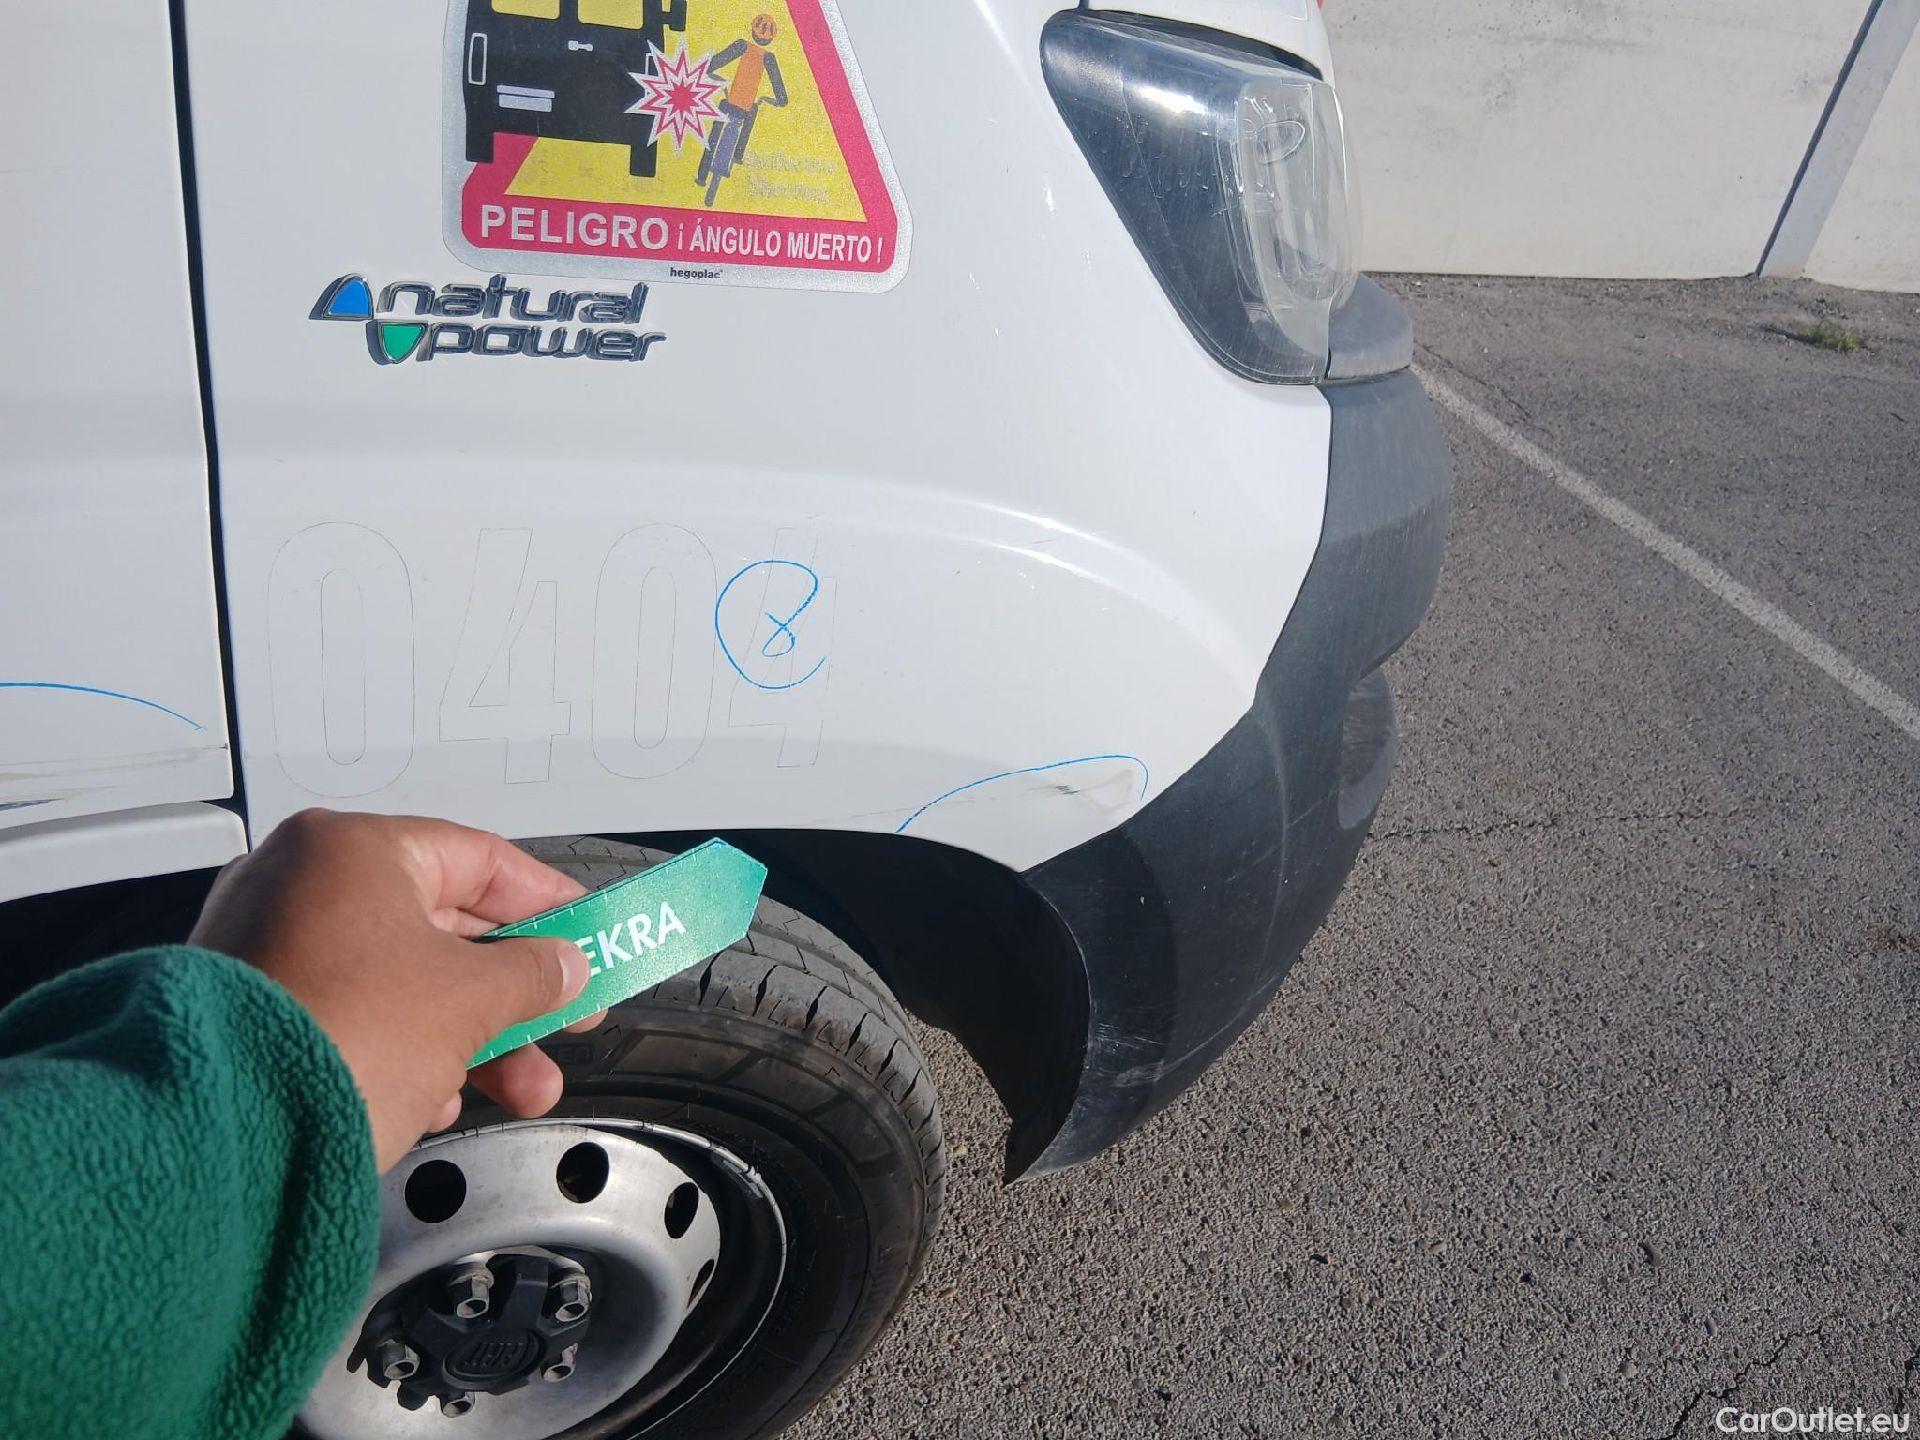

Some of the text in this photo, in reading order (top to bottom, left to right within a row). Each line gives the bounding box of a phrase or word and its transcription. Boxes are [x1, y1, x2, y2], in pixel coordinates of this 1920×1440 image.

[481, 204, 669, 250] PELIGRO
[376, 273, 649, 324] natural
[416, 319, 667, 362] power
[574, 901, 687, 977] EKRA
